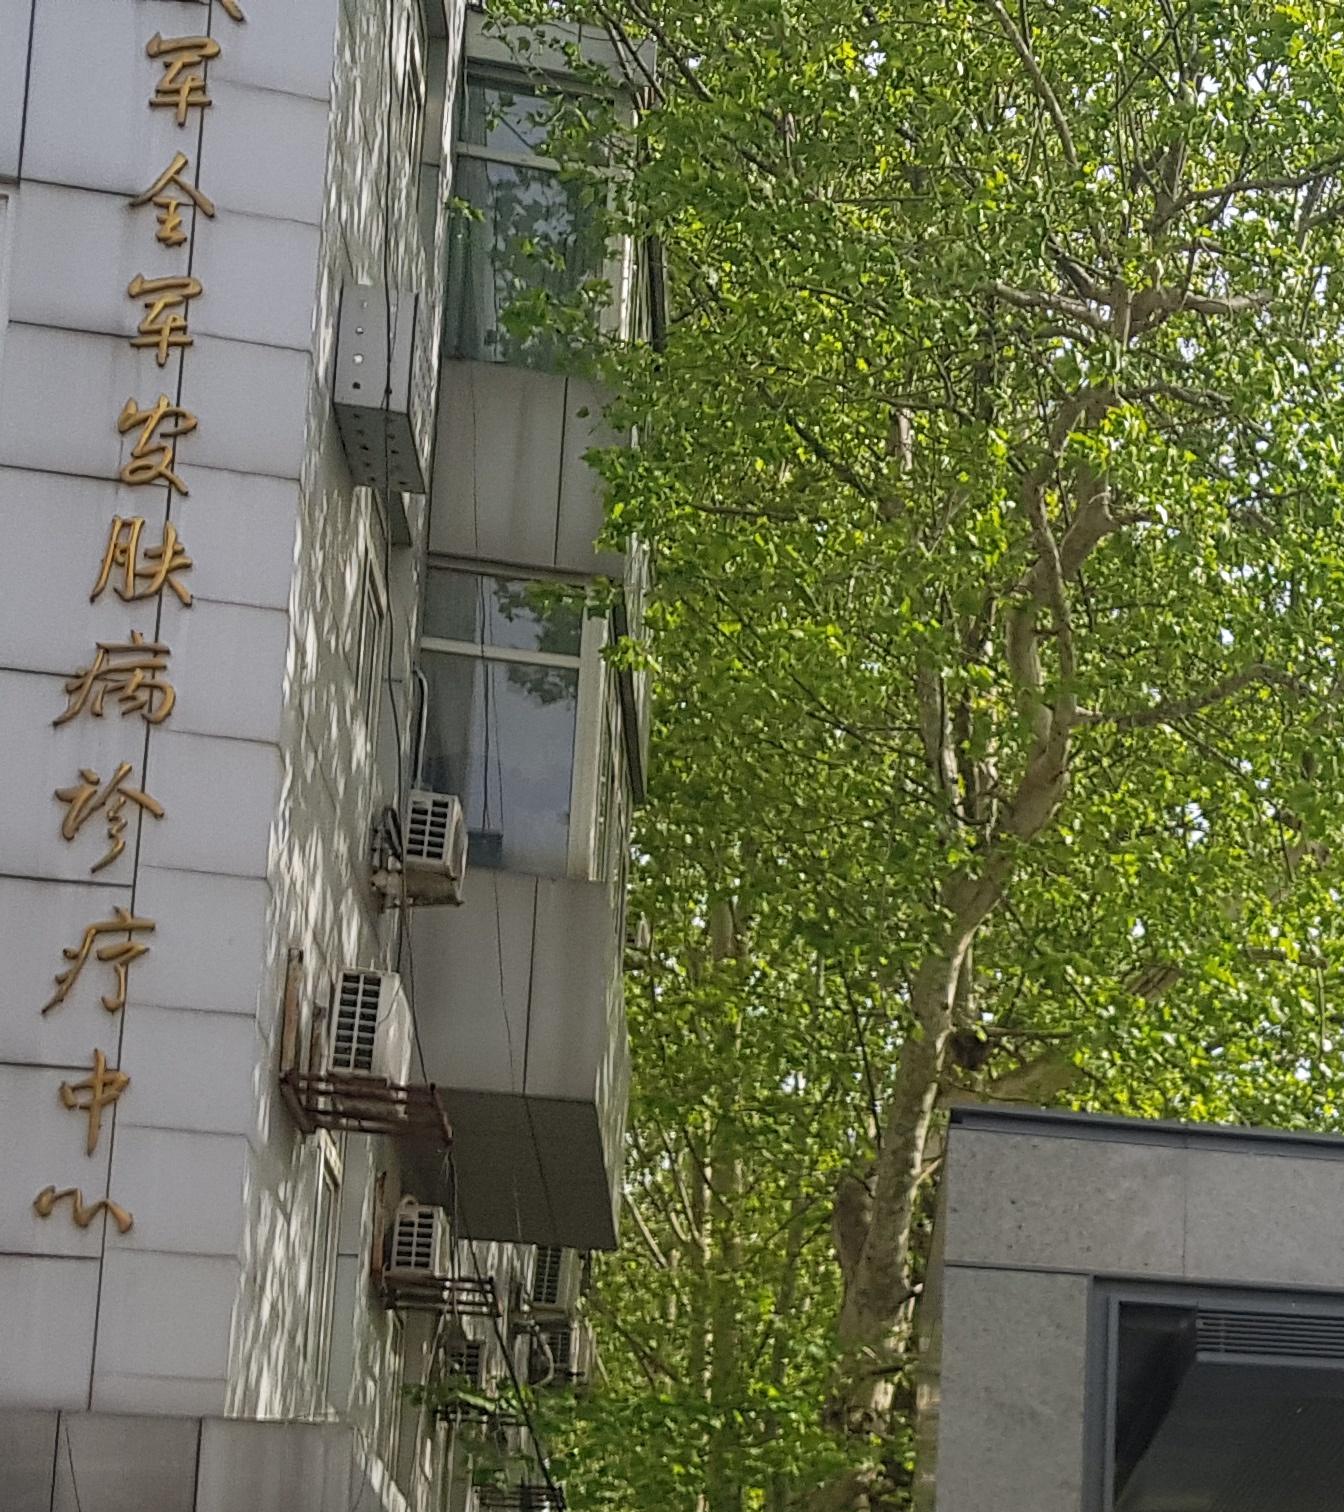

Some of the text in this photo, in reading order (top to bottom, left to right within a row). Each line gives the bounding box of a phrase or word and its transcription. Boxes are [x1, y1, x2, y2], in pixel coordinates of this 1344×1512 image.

[33, 0, 246, 1234] 军全军皮肤病诊疗中心
